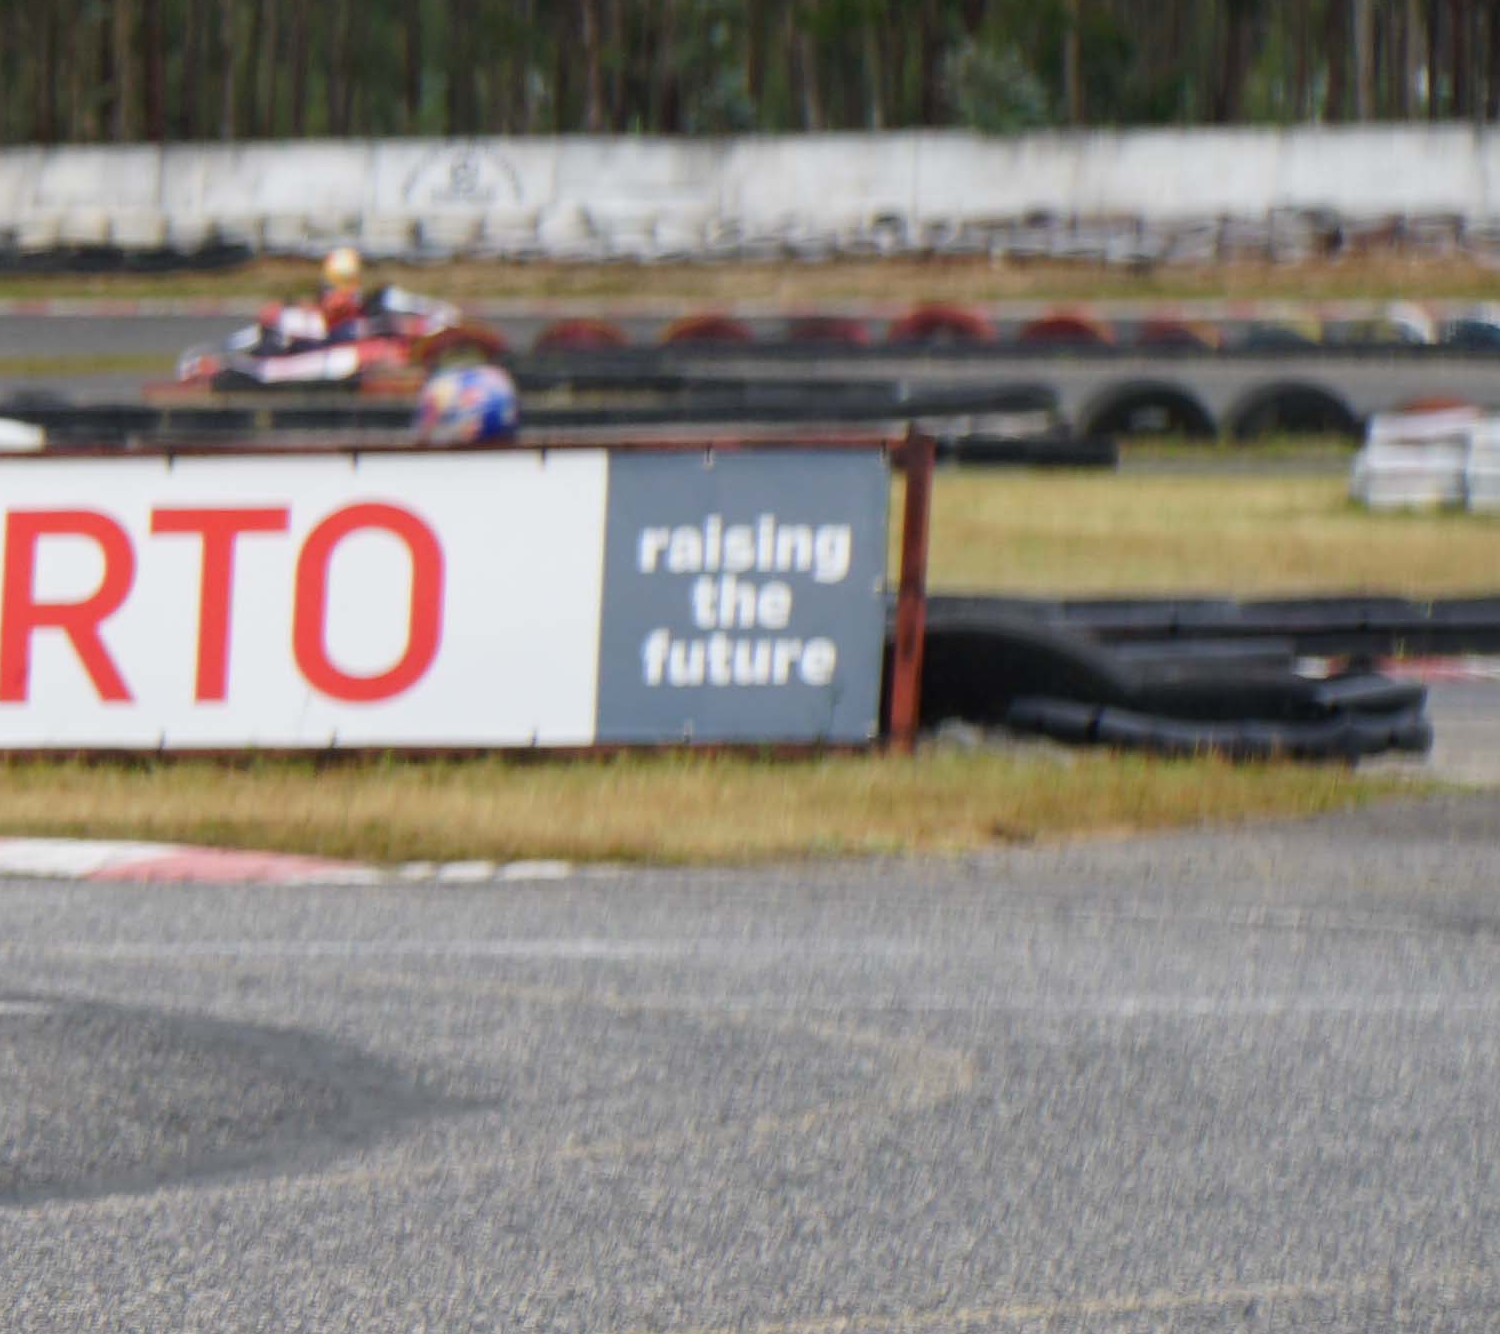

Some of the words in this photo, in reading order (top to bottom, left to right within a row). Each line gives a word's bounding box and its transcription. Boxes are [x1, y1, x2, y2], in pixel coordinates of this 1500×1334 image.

[639, 513, 851, 584] raising
[692, 573, 792, 630] the
[642, 627, 837, 687] future
